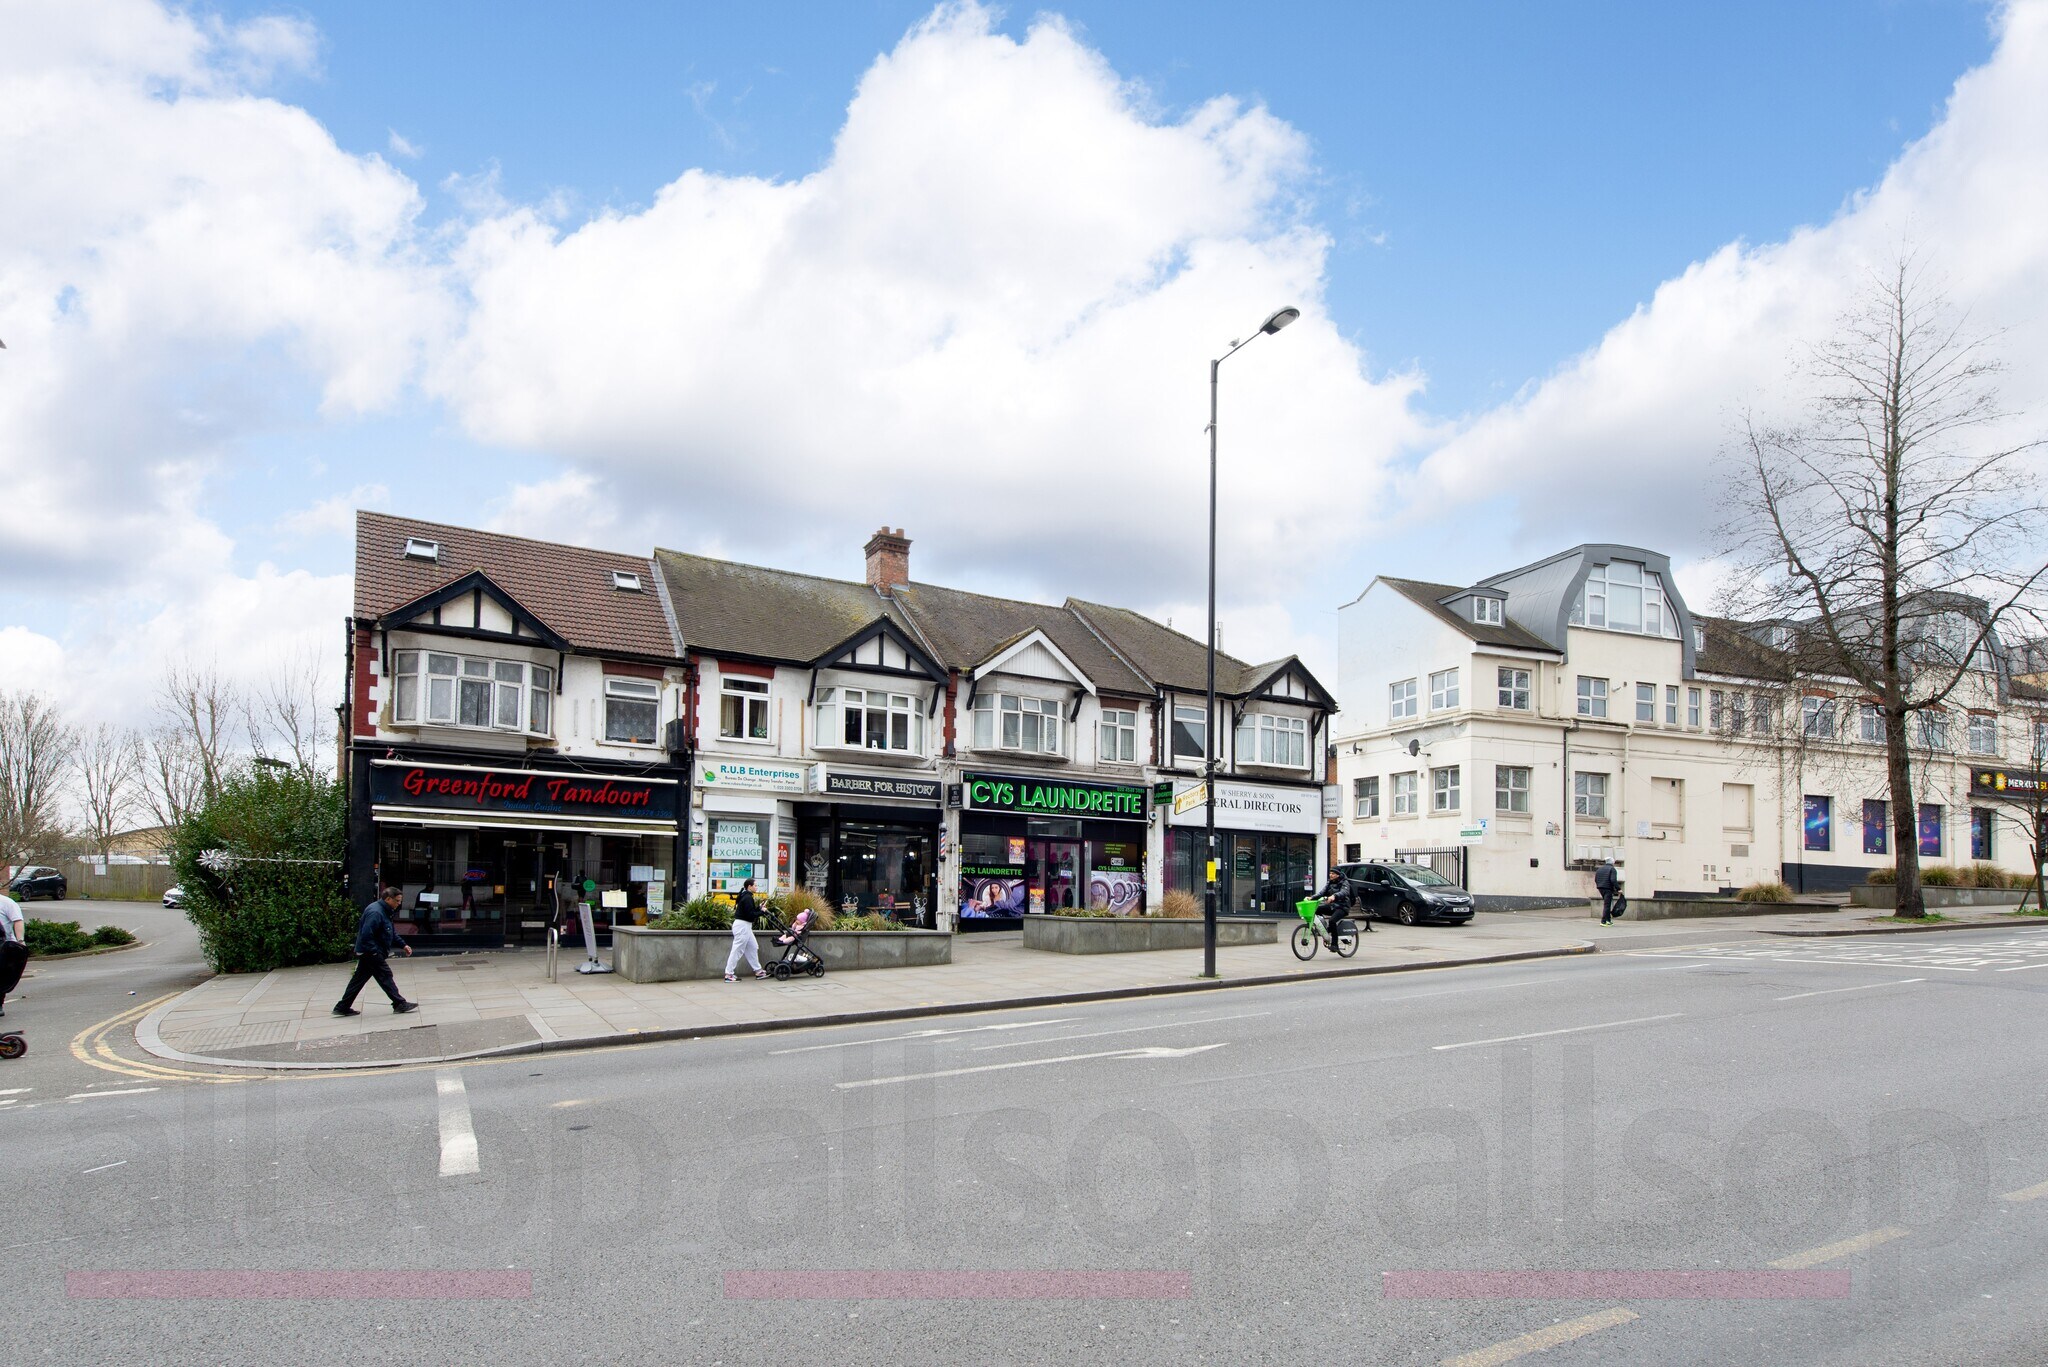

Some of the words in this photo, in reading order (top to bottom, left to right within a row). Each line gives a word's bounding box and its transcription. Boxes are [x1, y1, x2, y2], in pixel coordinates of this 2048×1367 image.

[720, 765, 746, 775] R.U.B
[748, 767, 800, 779] Enterprises
[403, 769, 536, 803] Greenford
[547, 779, 651, 806] Tandoori
[831, 777, 873, 792] BARBER
[873, 780, 895, 794] FOR
[895, 782, 936, 796] HISTORY
[2007, 778, 2039, 789] MERKUR
[971, 780, 1014, 805] CYS
[1020, 785, 1141, 814] LAUNDRETTE
[1227, 790, 1252, 798] SHERRY
[503, 800, 531, 810] Indian
[533, 801, 562, 812] Cuisine
[1213, 798, 1242, 809] ERAL
[1243, 800, 1302, 814] DIRECTORS
[716, 835, 759, 845] TRANSFER
[713, 848, 761, 857] EXCHANGE
[977, 867, 1023, 876] LAUNDRETTE
